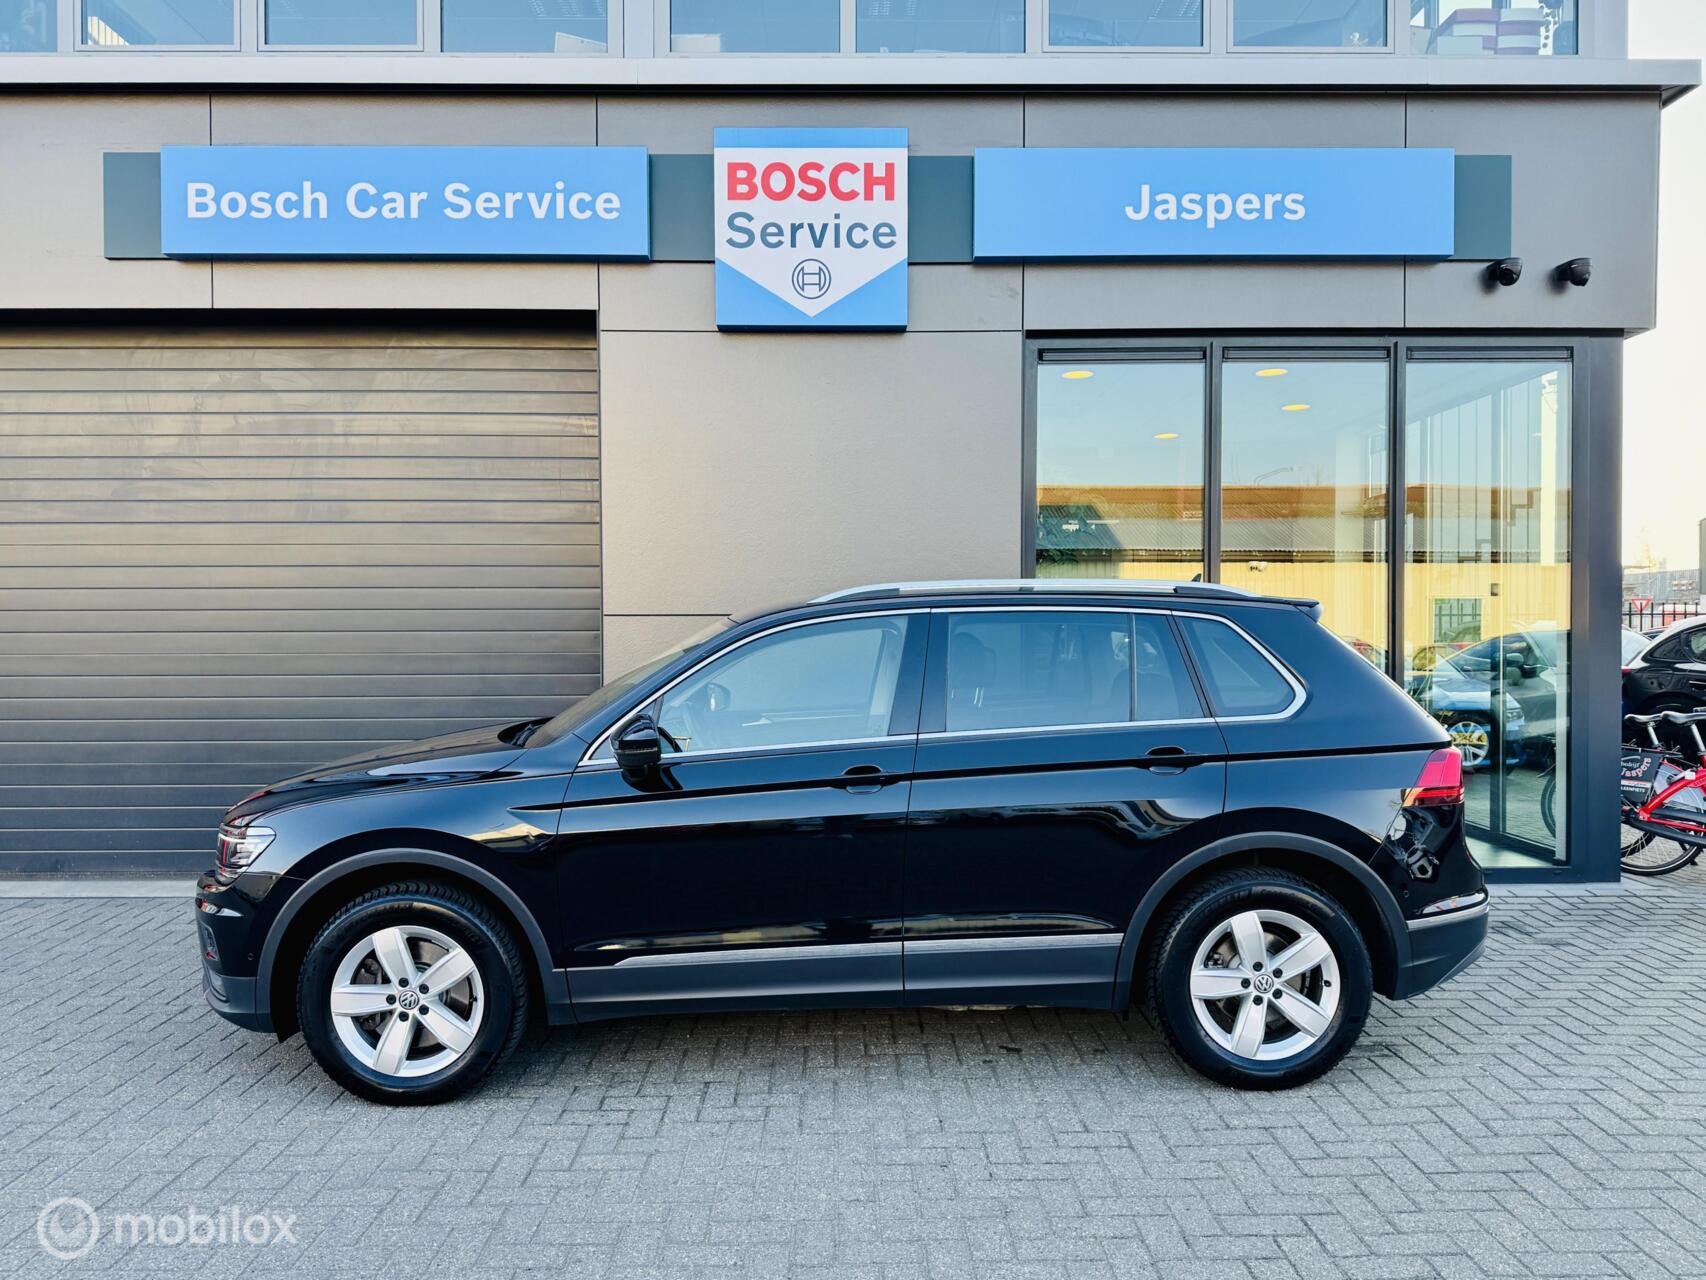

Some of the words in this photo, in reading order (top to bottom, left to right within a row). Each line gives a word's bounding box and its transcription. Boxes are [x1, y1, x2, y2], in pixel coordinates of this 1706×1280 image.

[187, 180, 328, 219] Bosch
[346, 182, 429, 219] Car
[443, 180, 621, 220] Service
[726, 161, 896, 203] BOSCH
[1124, 184, 1306, 229] Jaspers
[725, 211, 897, 250] Service
